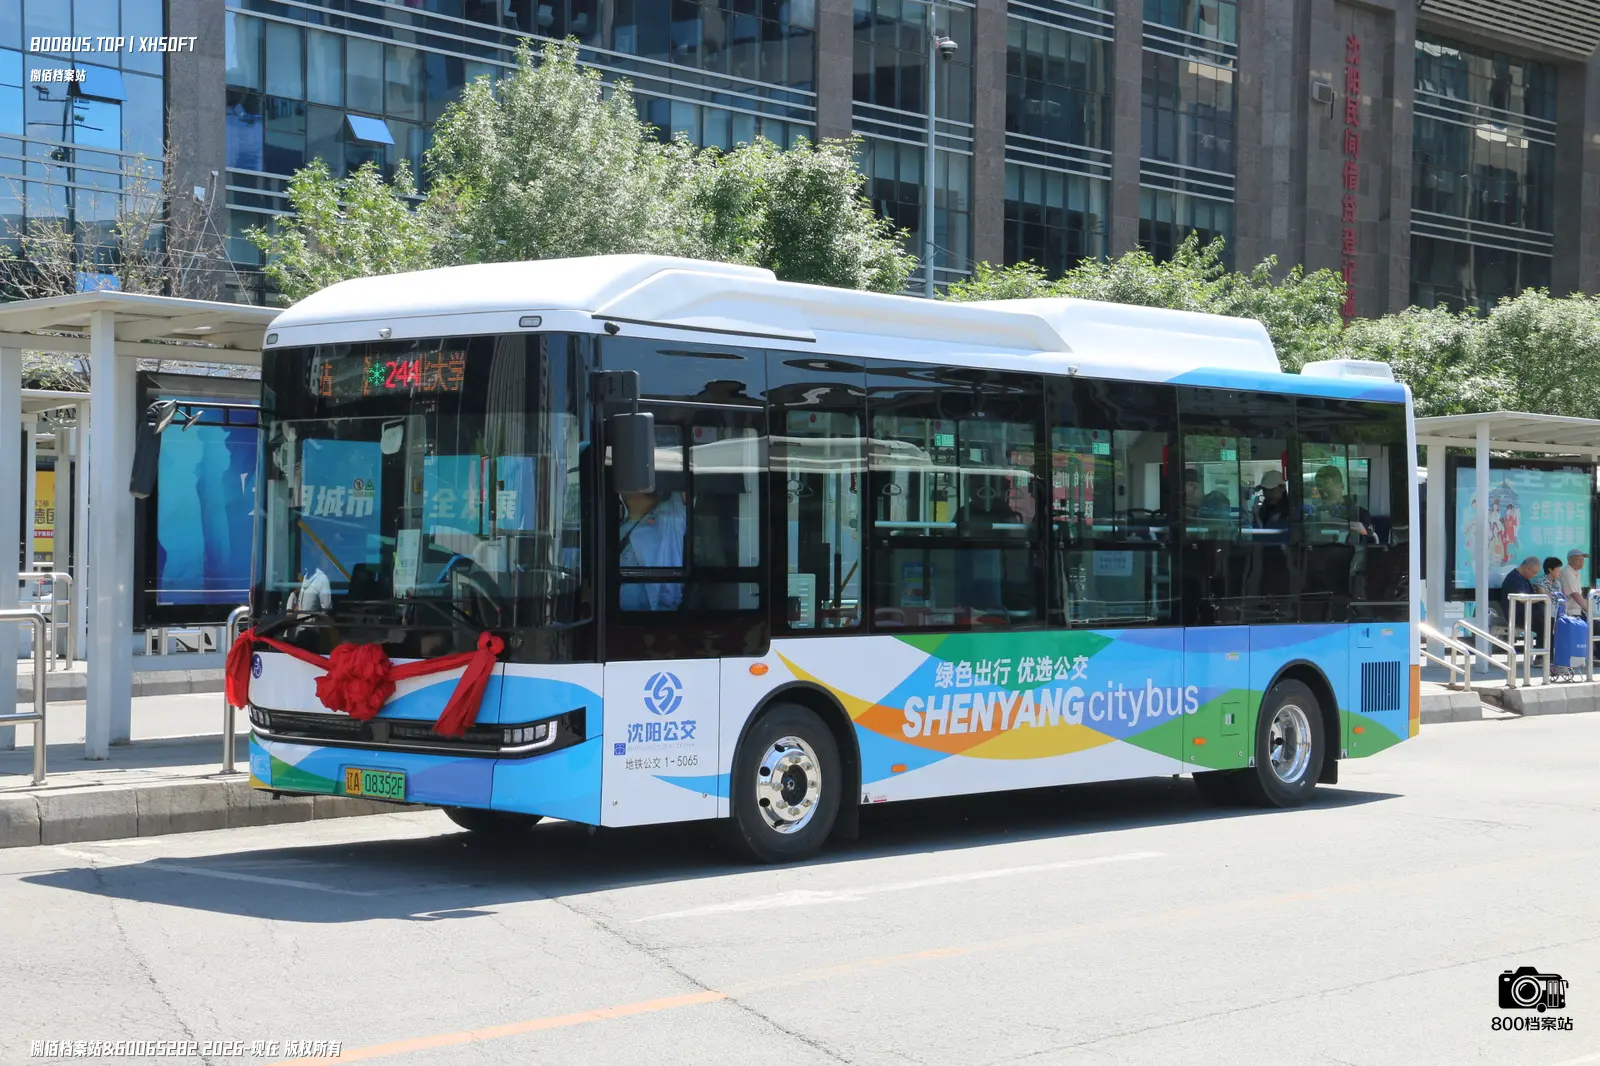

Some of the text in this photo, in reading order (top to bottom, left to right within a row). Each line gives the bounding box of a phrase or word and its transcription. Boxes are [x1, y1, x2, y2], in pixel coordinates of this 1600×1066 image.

[385, 359, 419, 388] 244
[934, 655, 1089, 689] 绿色出行 优选公交
[901, 678, 1199, 738] SHENYANG citybus
[627, 719, 697, 743] 沈阳公交
[625, 757, 661, 770] 地铁公交
